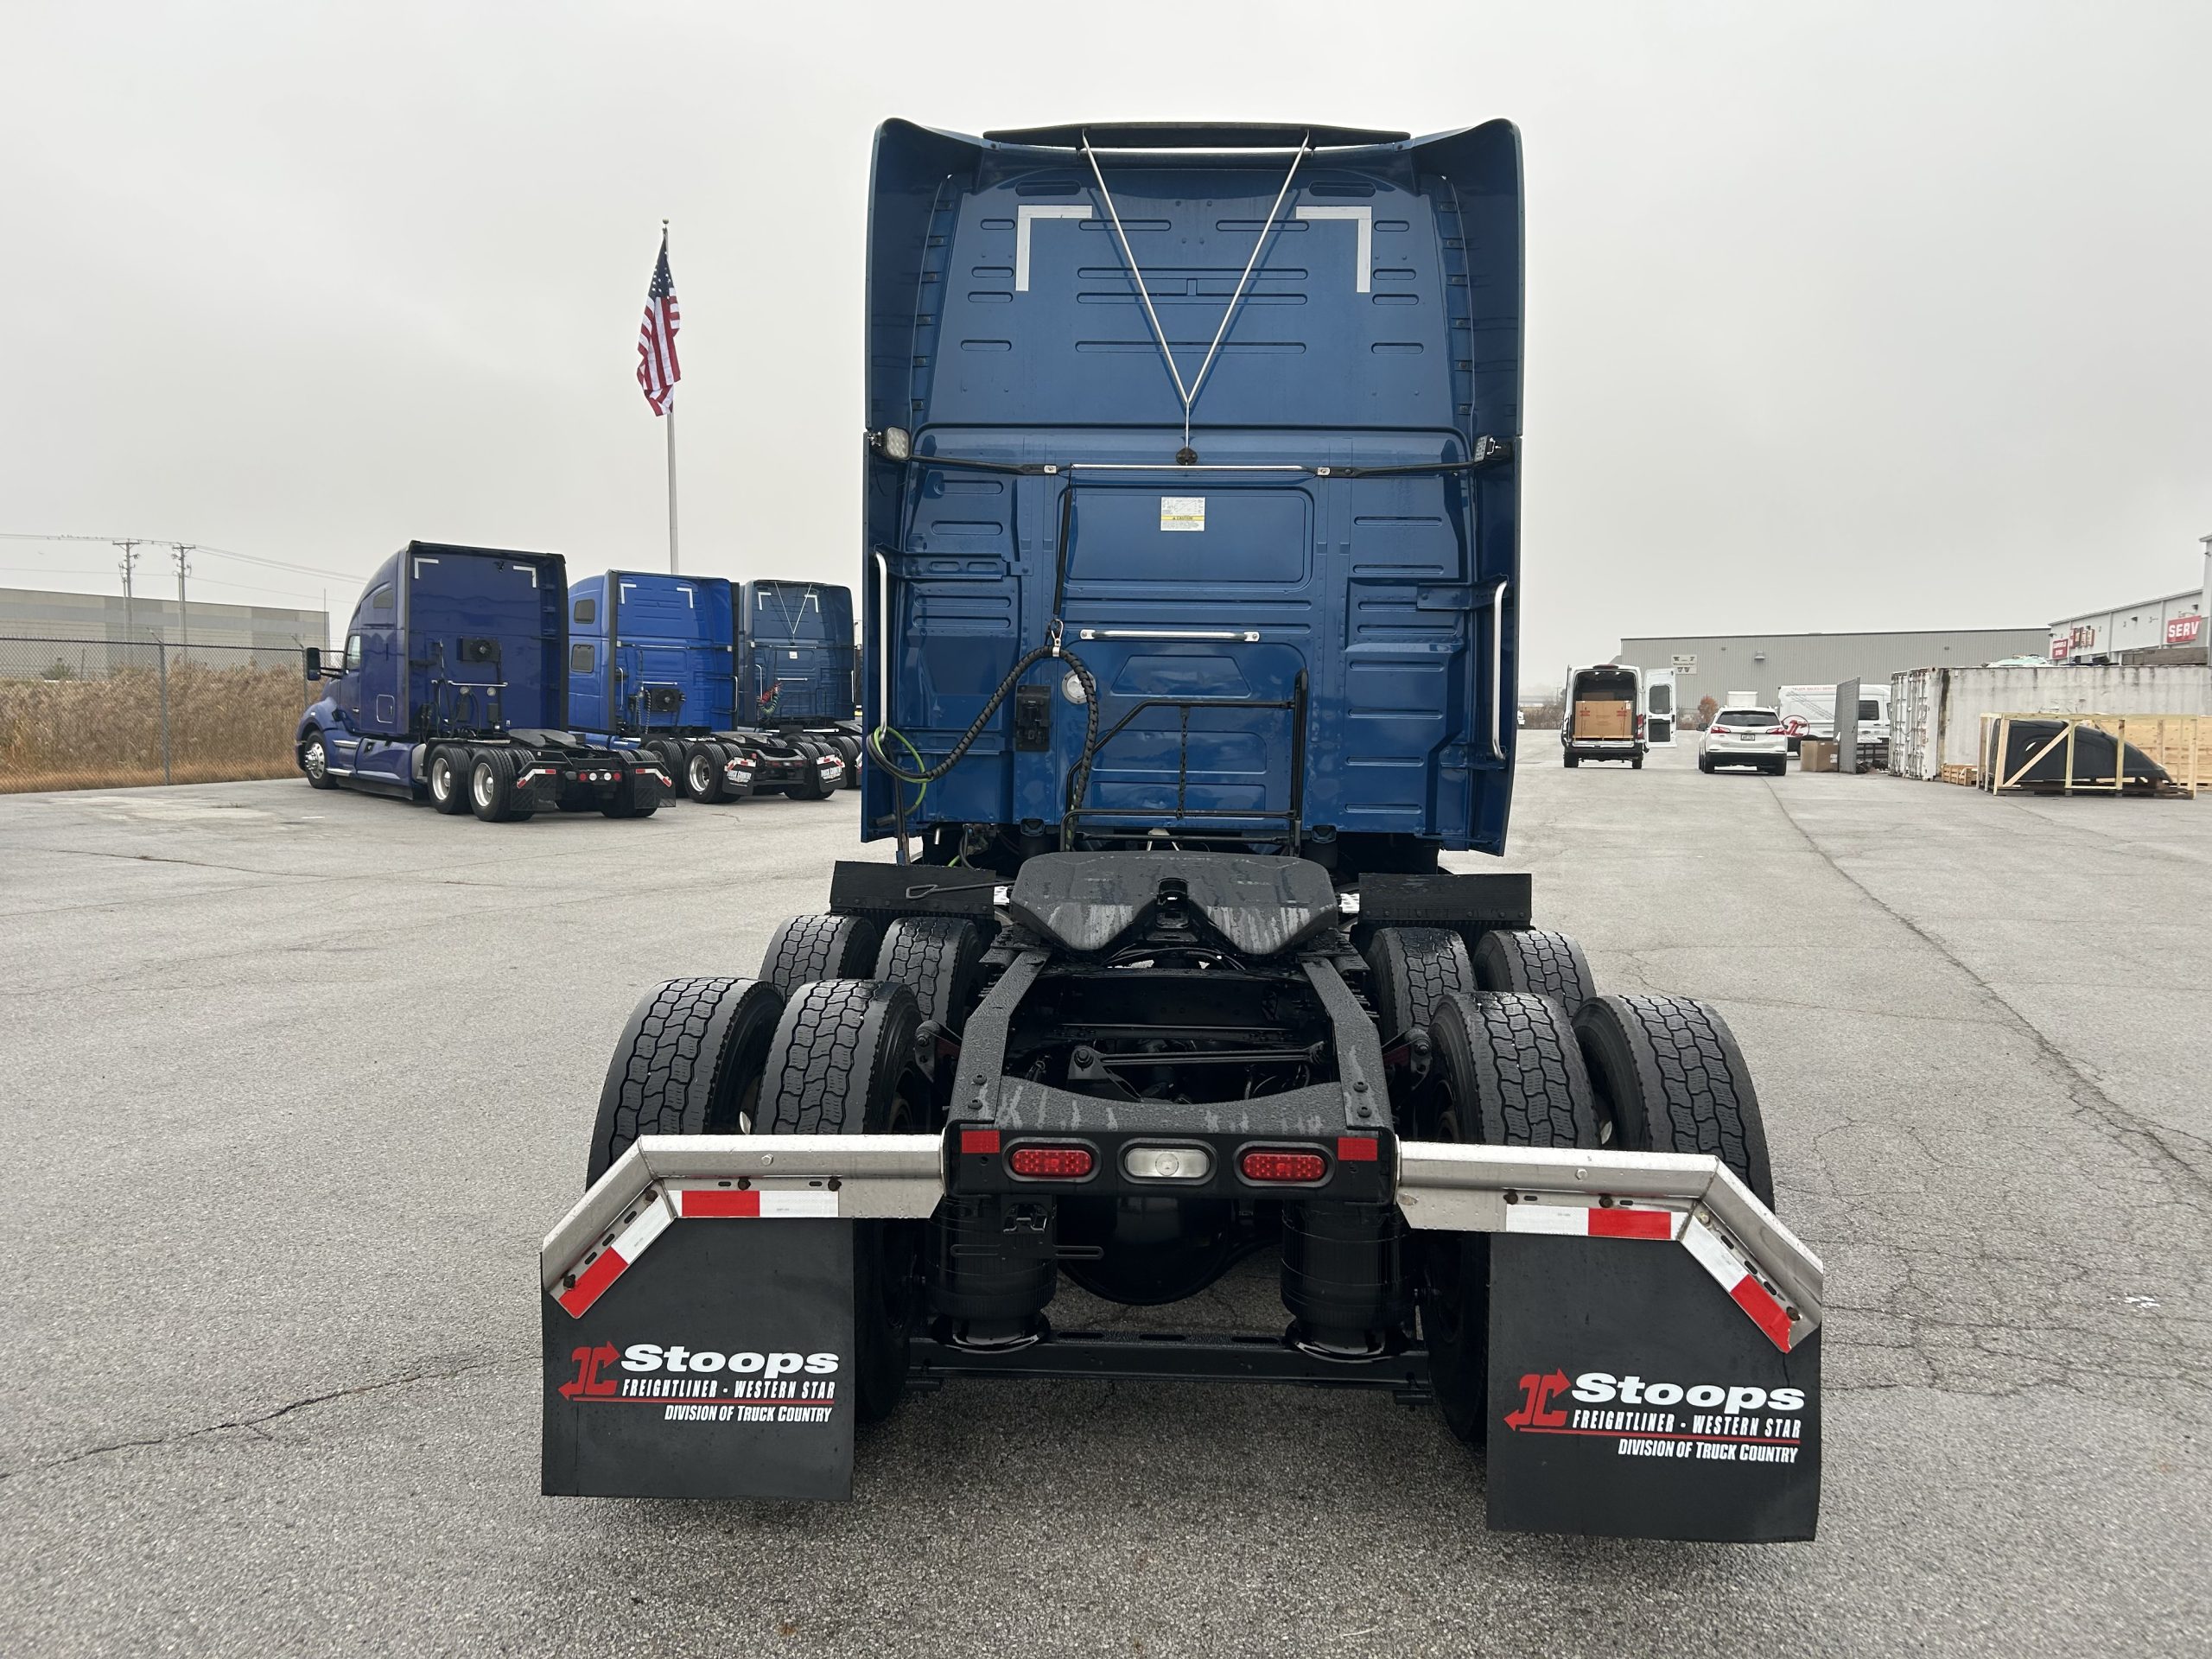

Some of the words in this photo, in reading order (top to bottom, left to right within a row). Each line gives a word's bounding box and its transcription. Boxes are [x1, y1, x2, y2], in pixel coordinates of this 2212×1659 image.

[2168, 621, 2200, 638] SERV
[621, 1344, 839, 1378] Stoops
[621, 1378, 718, 1398] FREIGHTLINER
[734, 1380, 798, 1399] WESTERN
[801, 1382, 836, 1400] STAR
[1571, 1372, 1805, 1414] Stoops
[664, 1405, 717, 1421] DIVISION
[718, 1406, 735, 1421] OF
[736, 1405, 776, 1422] TRUCK
[777, 1406, 833, 1423] COUNTRY
[1573, 1409, 1675, 1433] FREIGHTLINER
[1692, 1414, 1759, 1437] WESTERN
[1764, 1419, 1802, 1440] STAR
[1618, 1439, 1675, 1458] DIVISION
[1676, 1440, 1693, 1459] OF
[1694, 1440, 1738, 1460] TRUCK
[1738, 1443, 1799, 1464] COUNTRY
